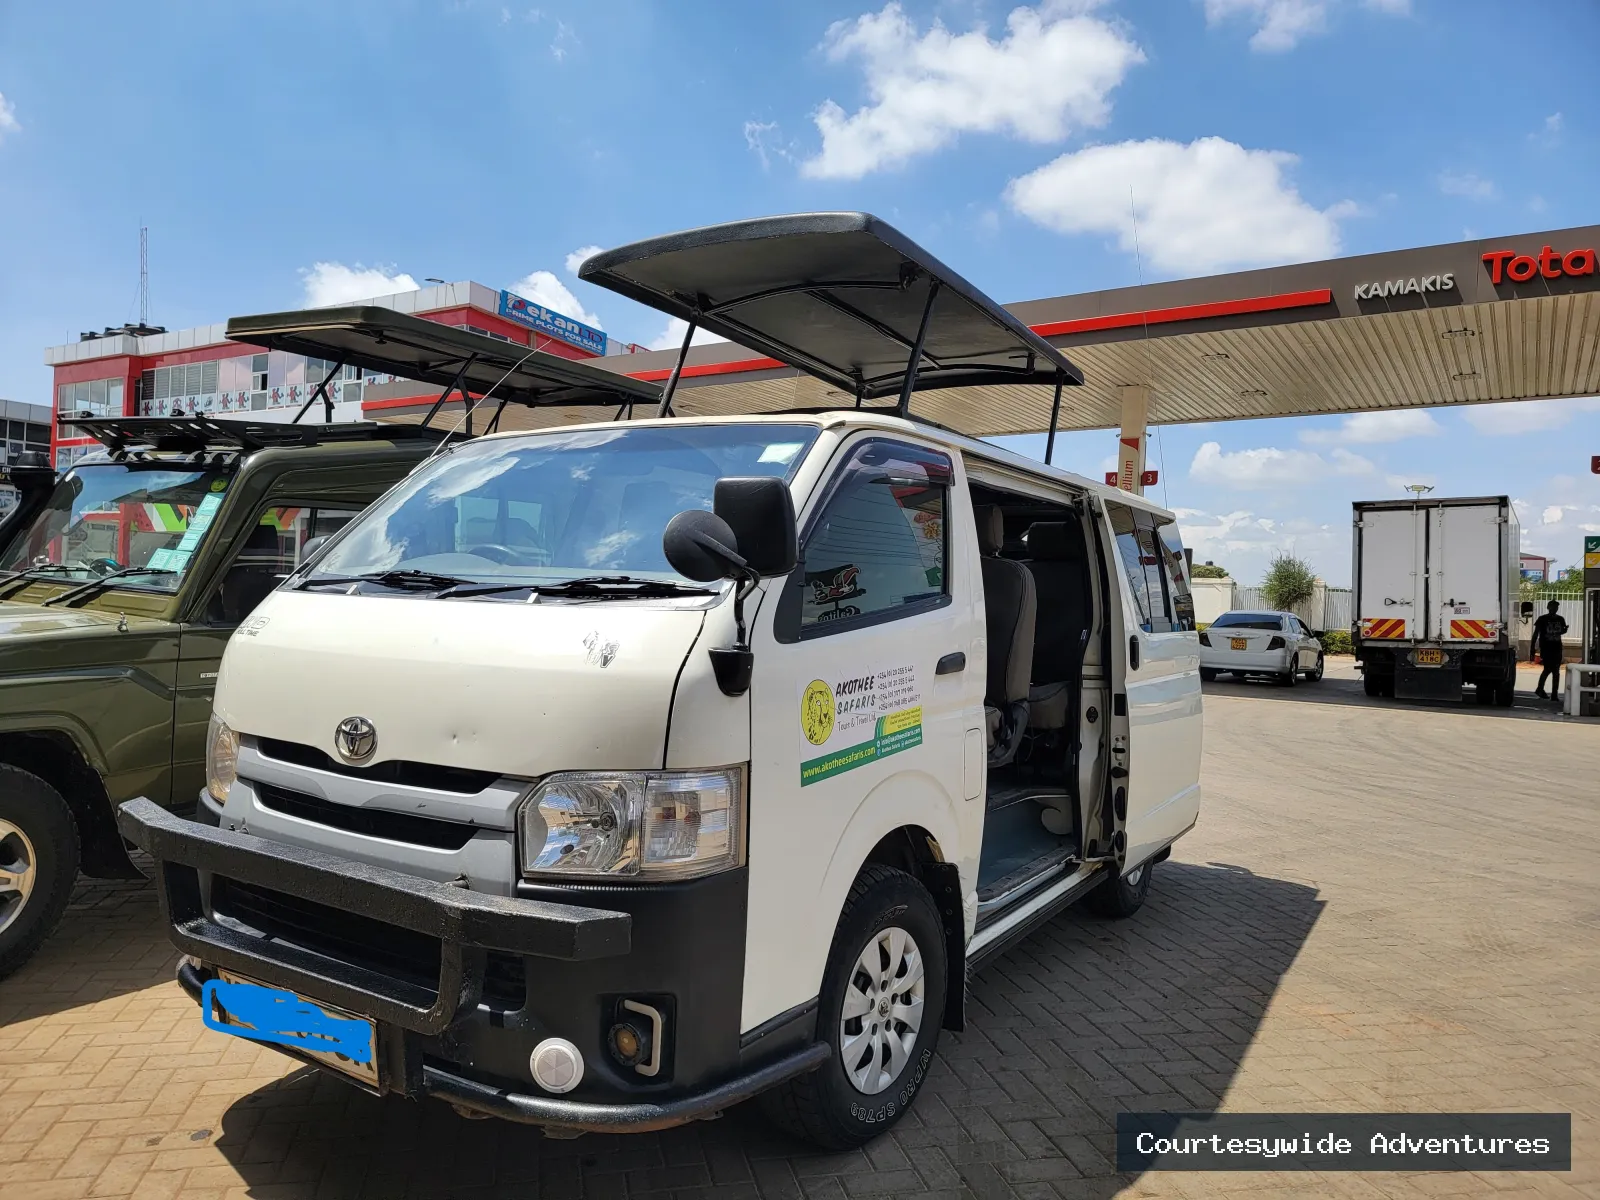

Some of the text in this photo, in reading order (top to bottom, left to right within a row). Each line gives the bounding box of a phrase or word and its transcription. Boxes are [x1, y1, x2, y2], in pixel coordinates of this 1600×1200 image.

[1482, 245, 1600, 284] Tota
[1354, 273, 1454, 300] KAMAKIS
[506, 308, 534, 324] PRIME
[536, 320, 564, 335] PLOTS
[565, 332, 582, 342] FOR
[582, 338, 603, 351] SALE
[1110, 475, 1117, 484] 4
[1122, 460, 1134, 493] ellium
[1147, 474, 1153, 483] 3
[836, 675, 875, 697] AKOTHEE
[837, 694, 876, 715] SAFARIS
[837, 720, 850, 732] Tours
[851, 719, 856, 727] &
[856, 715, 868, 726] Travel
[803, 746, 876, 778] www.akotheesafaris.com
